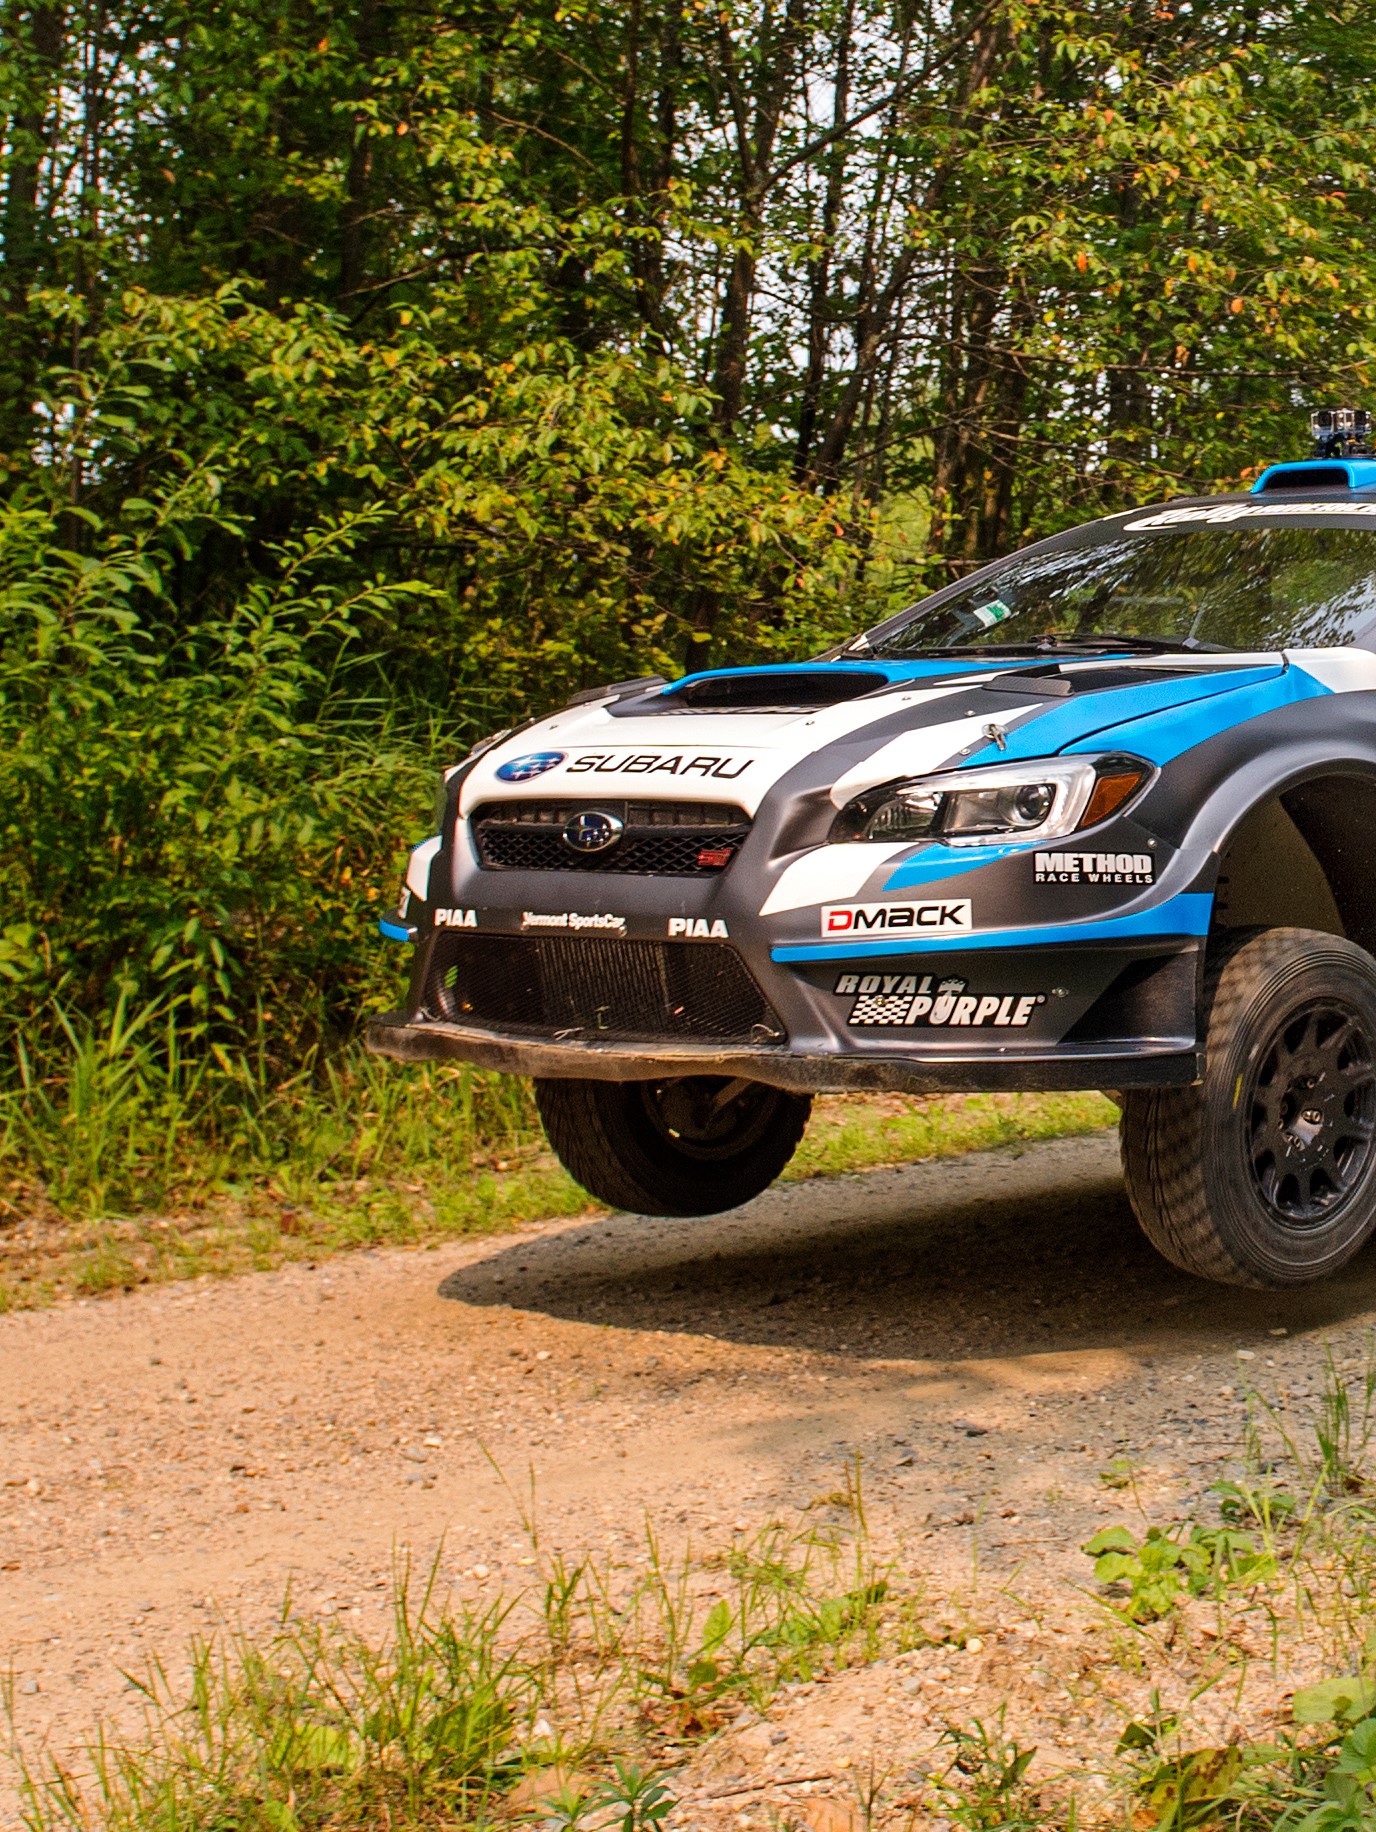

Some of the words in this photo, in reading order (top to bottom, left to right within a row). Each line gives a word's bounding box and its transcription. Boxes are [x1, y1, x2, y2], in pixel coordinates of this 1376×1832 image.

[566, 754, 755, 779] SUBARU
[1035, 852, 1152, 874] METHOD
[1035, 873, 1080, 884] RACE
[1088, 873, 1153, 884] WHEELS
[434, 908, 478, 928] PIAA
[667, 917, 730, 938] PIAA
[835, 974, 932, 994] ROYAL
[904, 994, 1037, 1026] PURPLE
